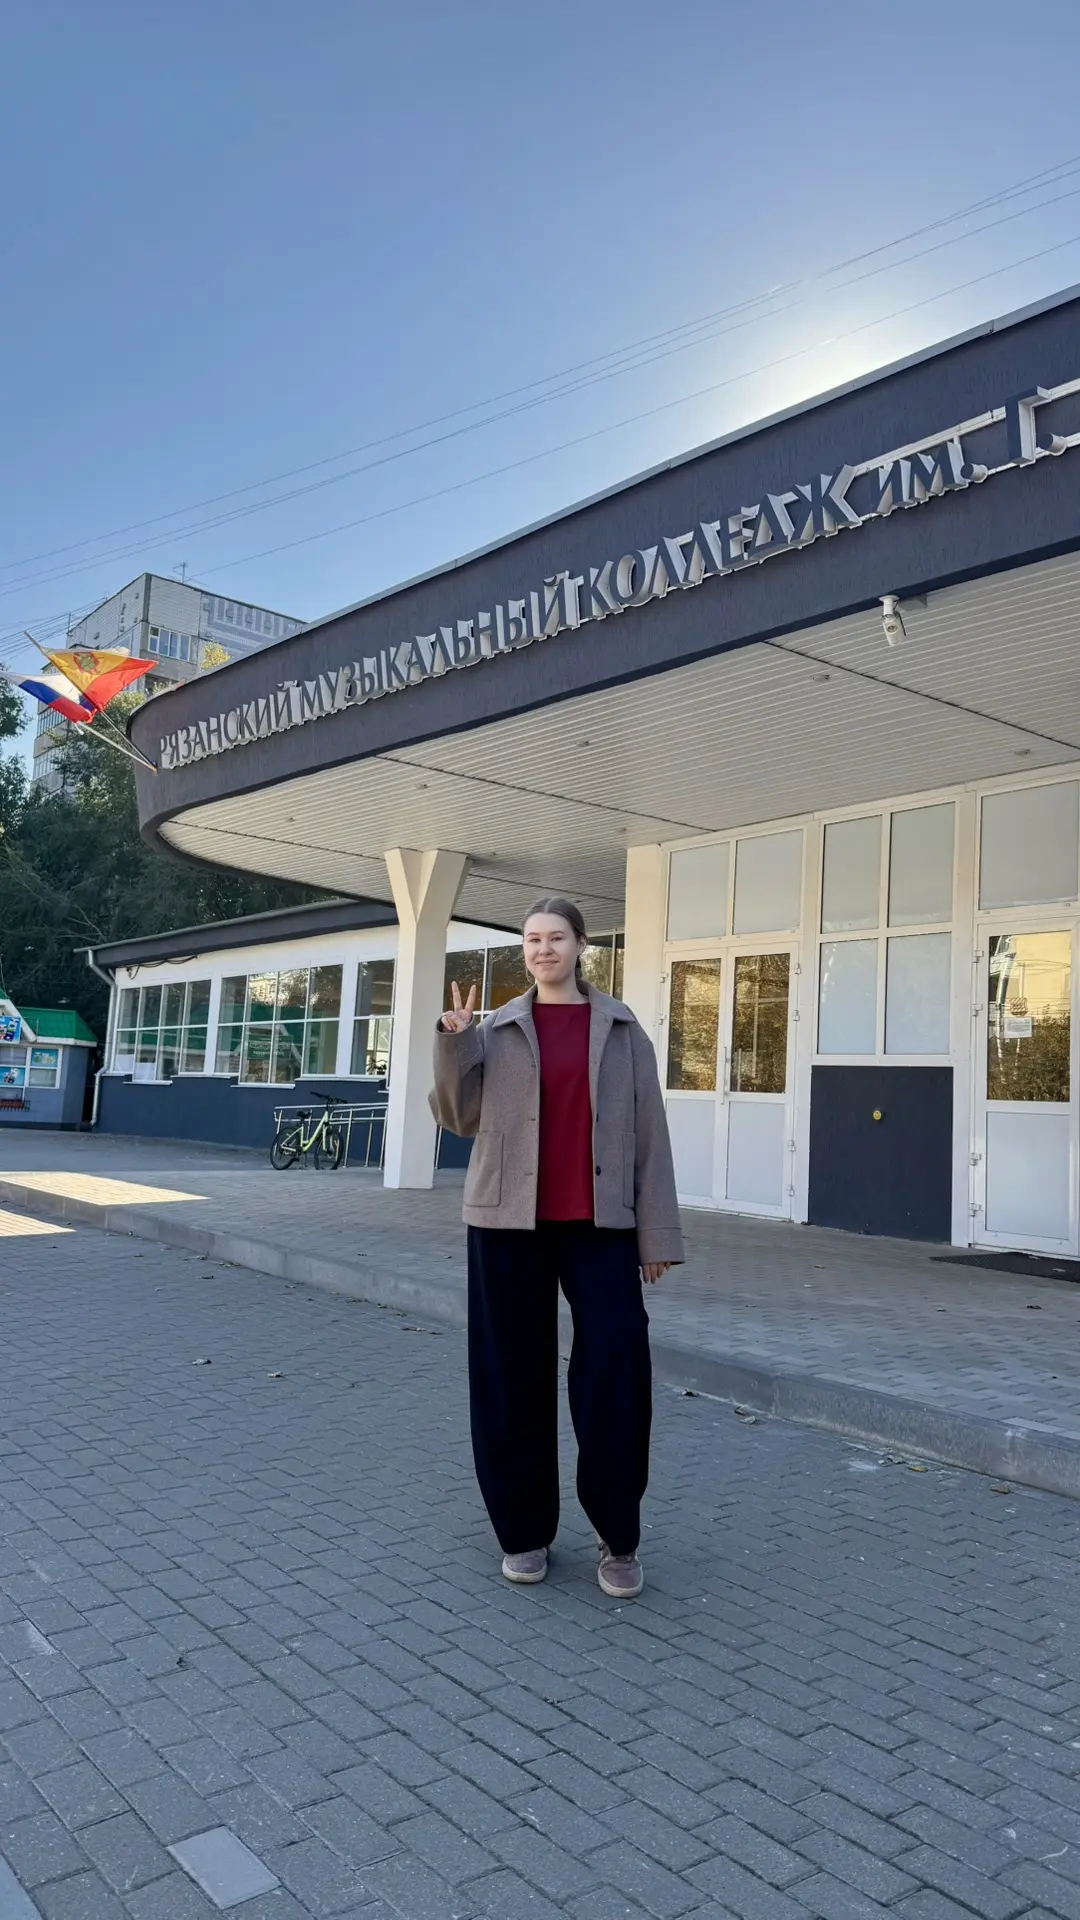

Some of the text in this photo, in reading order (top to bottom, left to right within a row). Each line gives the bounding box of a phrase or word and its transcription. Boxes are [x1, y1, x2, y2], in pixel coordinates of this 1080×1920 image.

[160, 386, 1067, 769] РЯЗАНСКИЙ МУЗЫКАЛЬНЫЙ КОЛЛЕДЖ ИМ. Г.
